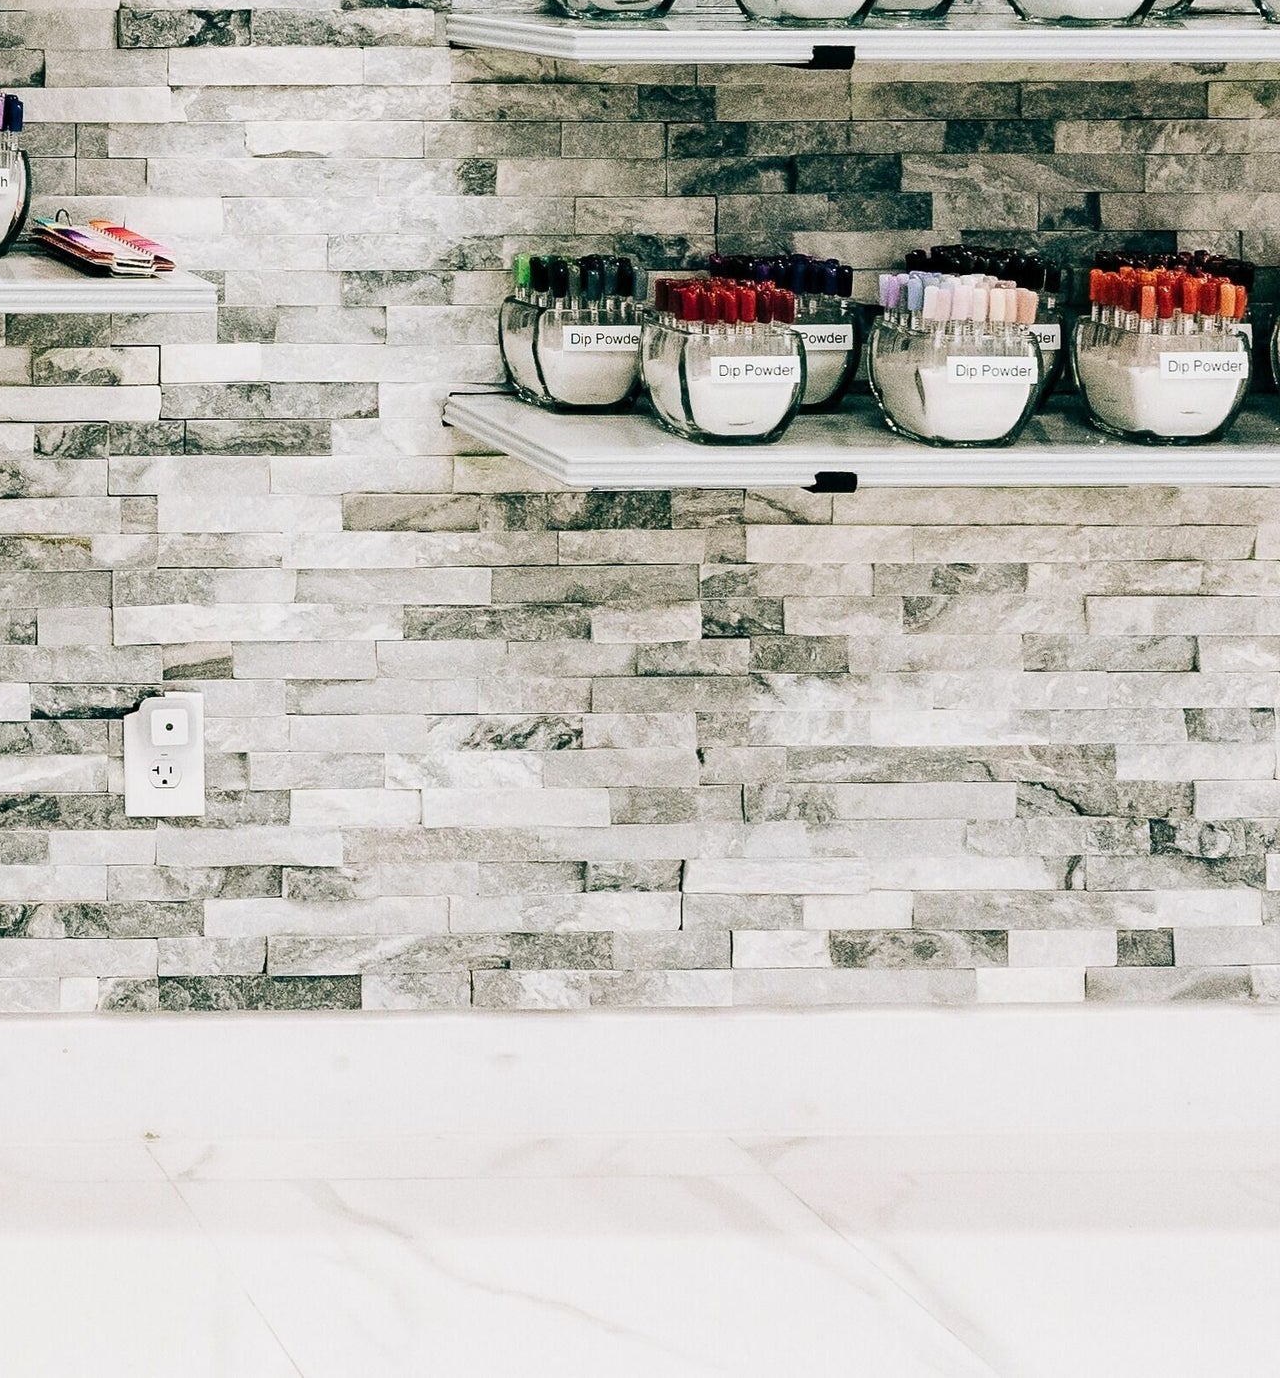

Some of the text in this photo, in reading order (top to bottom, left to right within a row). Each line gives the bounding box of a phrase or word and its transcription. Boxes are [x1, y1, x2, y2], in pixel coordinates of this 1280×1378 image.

[570, 331, 639, 348] Dip Powde
[718, 363, 795, 378] Dip Powder
[955, 364, 1033, 379] Dip Powder
[1167, 359, 1243, 375] Dip Powder
